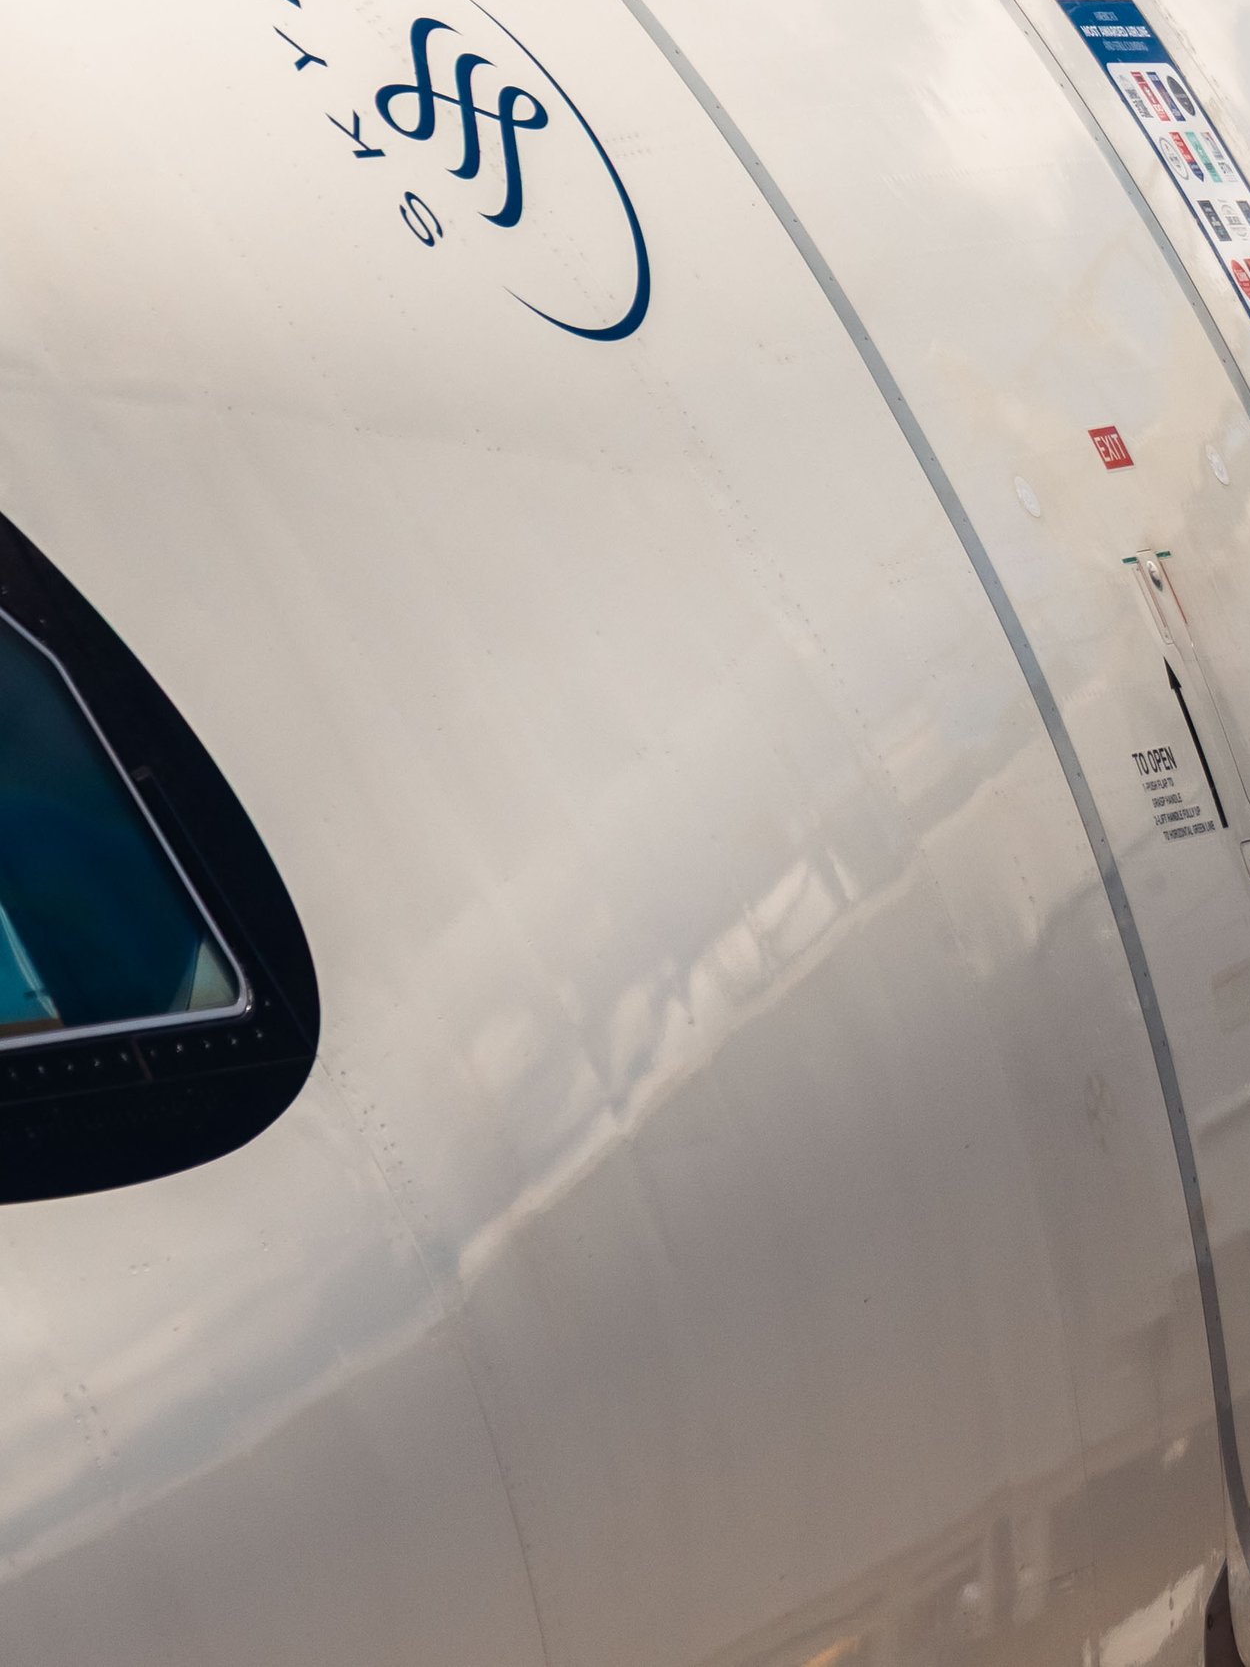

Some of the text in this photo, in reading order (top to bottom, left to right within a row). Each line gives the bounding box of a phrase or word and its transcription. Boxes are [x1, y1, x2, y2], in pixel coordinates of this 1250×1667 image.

[1094, 433, 1126, 462] EXIT
[1132, 746, 1177, 776] TO OPEN
